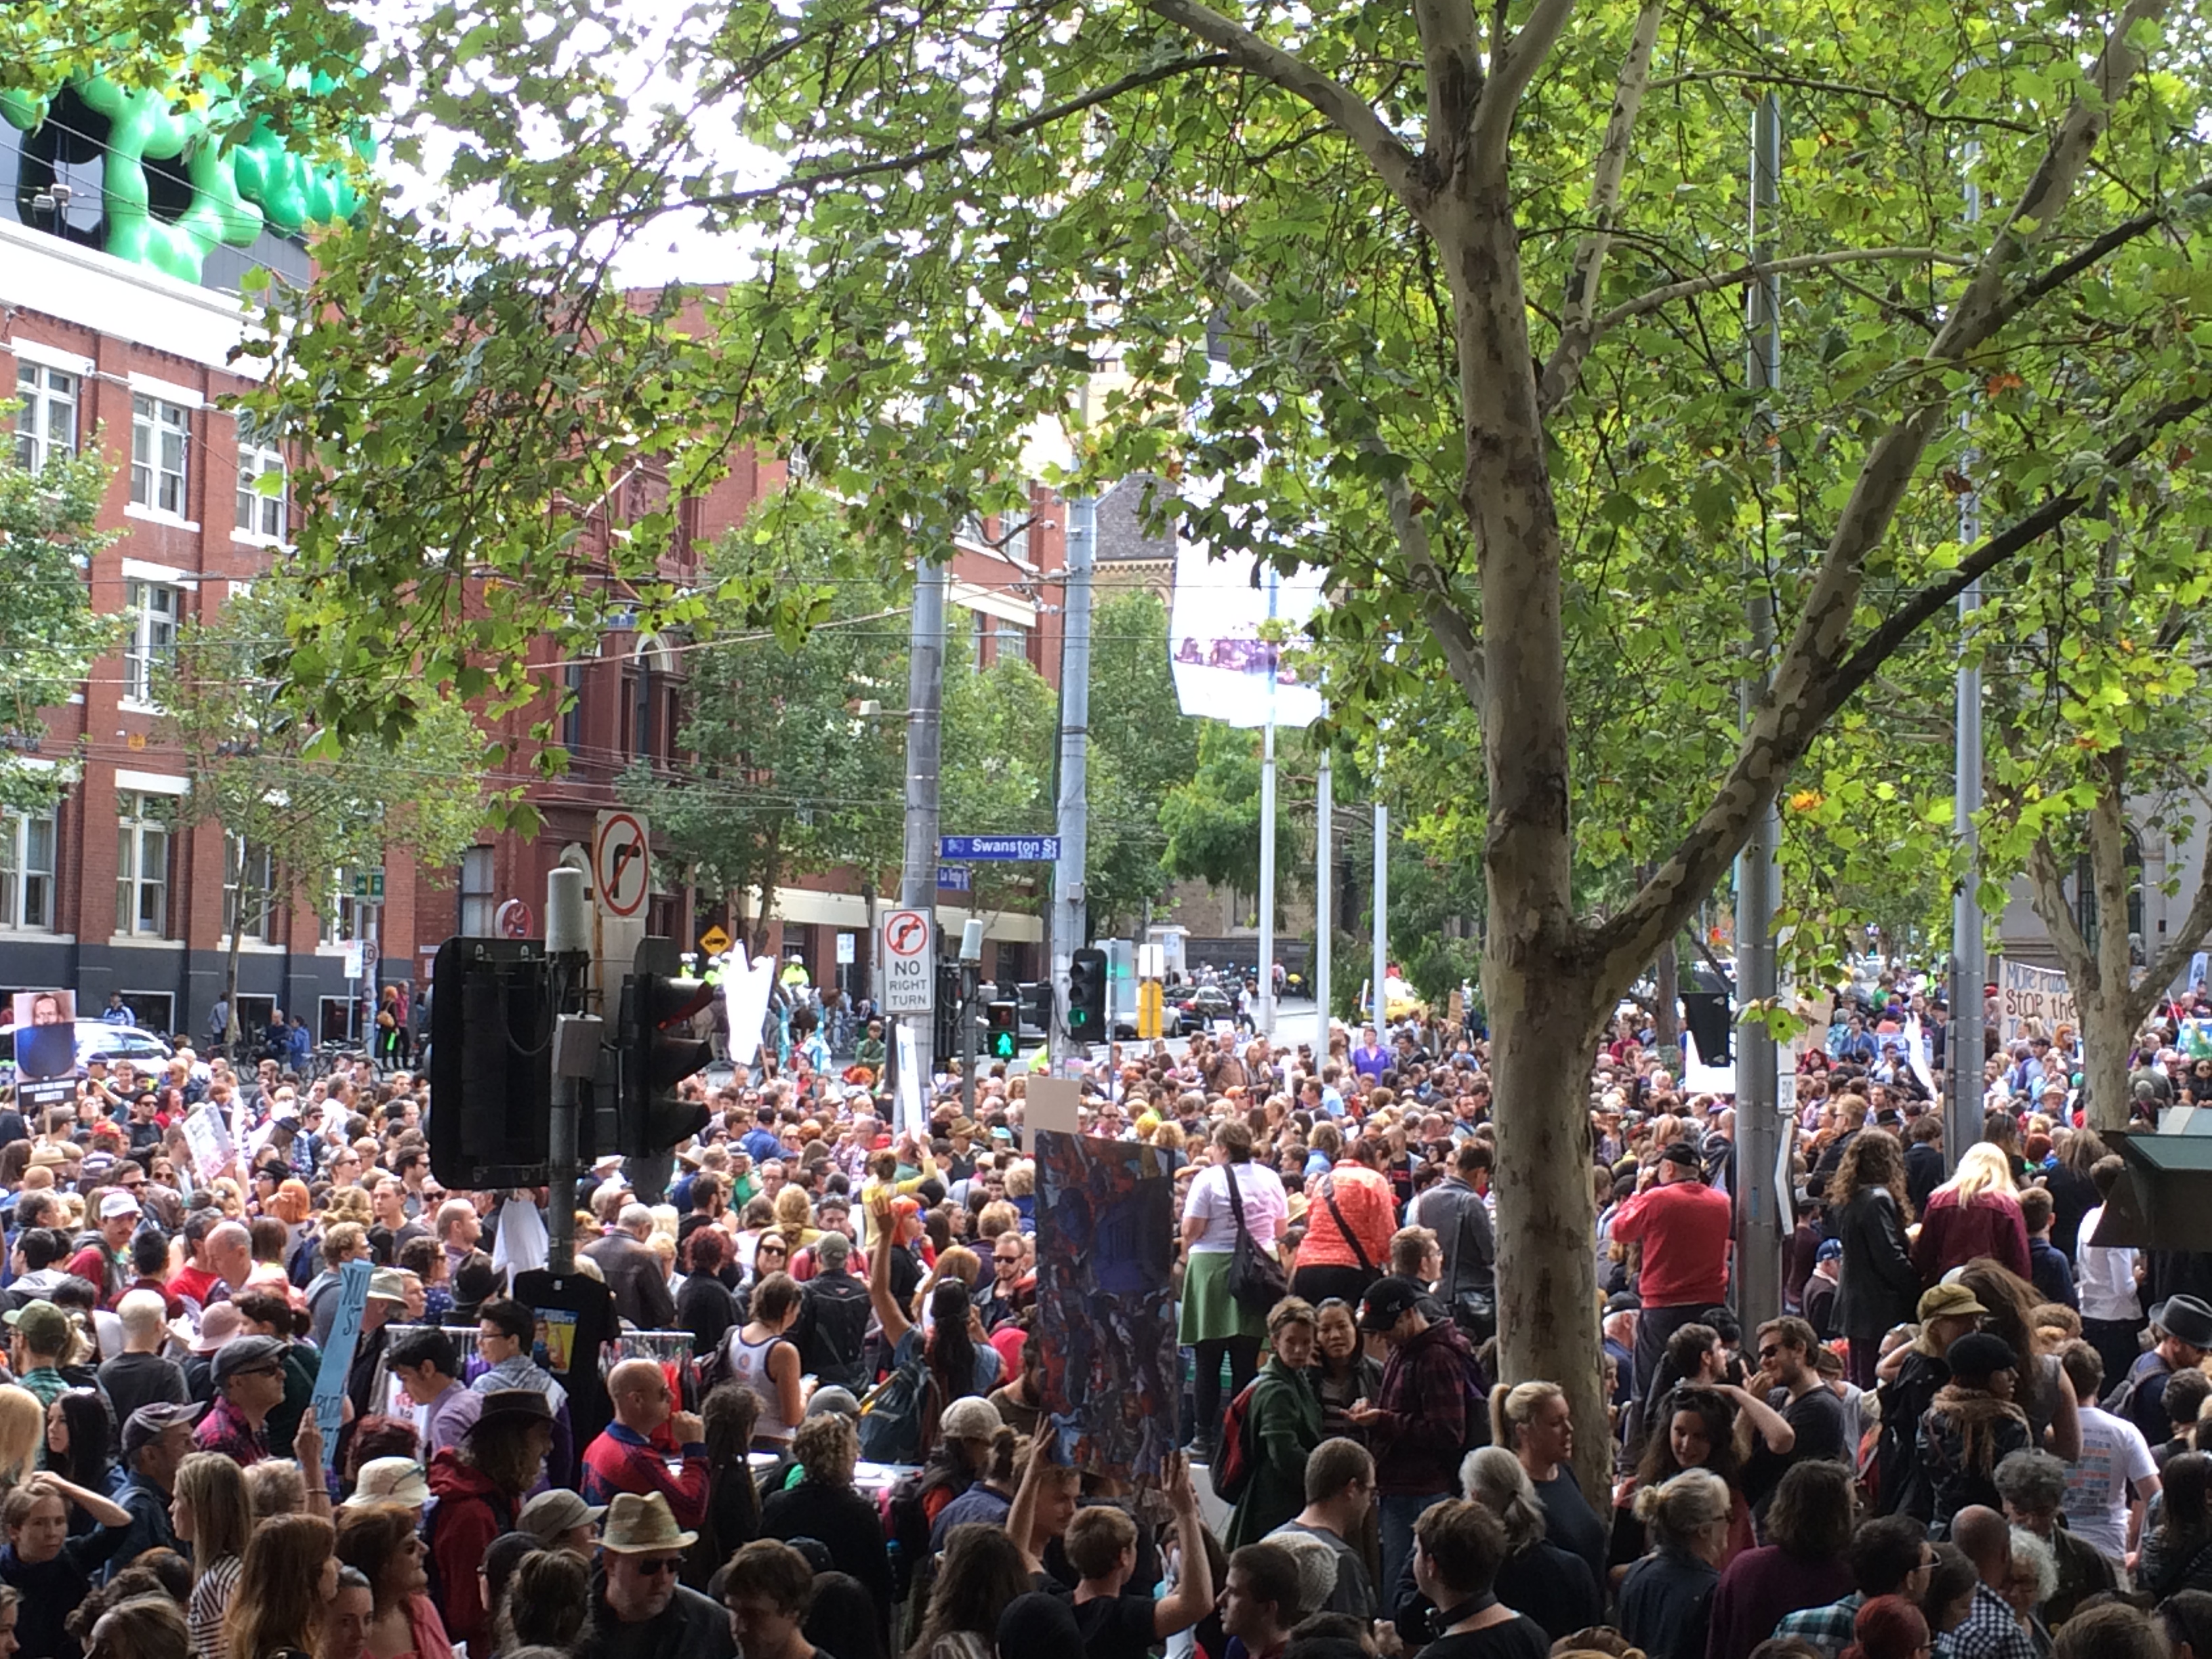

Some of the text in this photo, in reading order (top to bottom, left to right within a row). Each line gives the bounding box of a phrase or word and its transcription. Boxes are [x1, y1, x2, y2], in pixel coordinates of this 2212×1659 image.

[972, 838, 1057, 852] Swanston St
[894, 961, 920, 976] NO
[889, 979, 926, 990] RIGHT
[891, 995, 926, 1006] TURN
